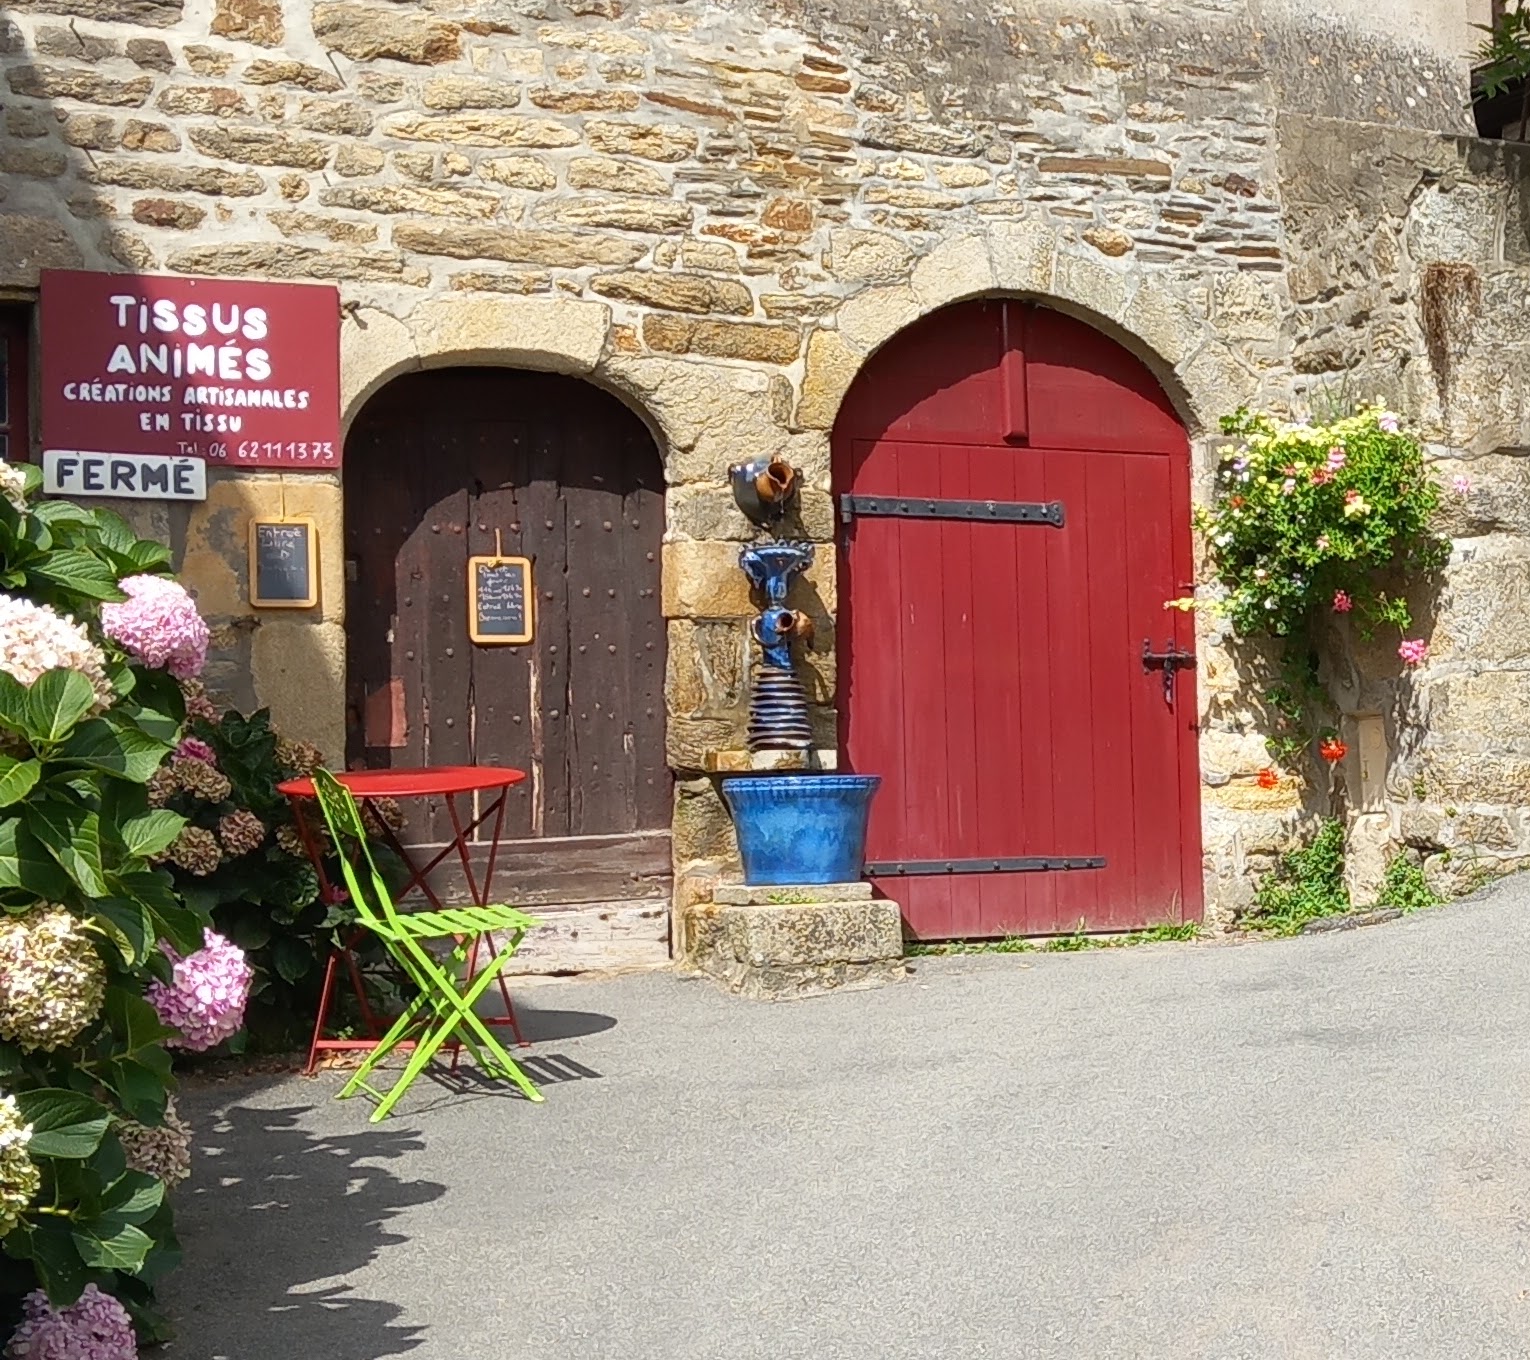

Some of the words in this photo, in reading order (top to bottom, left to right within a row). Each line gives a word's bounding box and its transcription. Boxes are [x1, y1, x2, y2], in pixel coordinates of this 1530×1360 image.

[140, 413, 170, 432] EN
[209, 442, 227, 458] 06
[56, 458, 196, 494] FERMÉ
